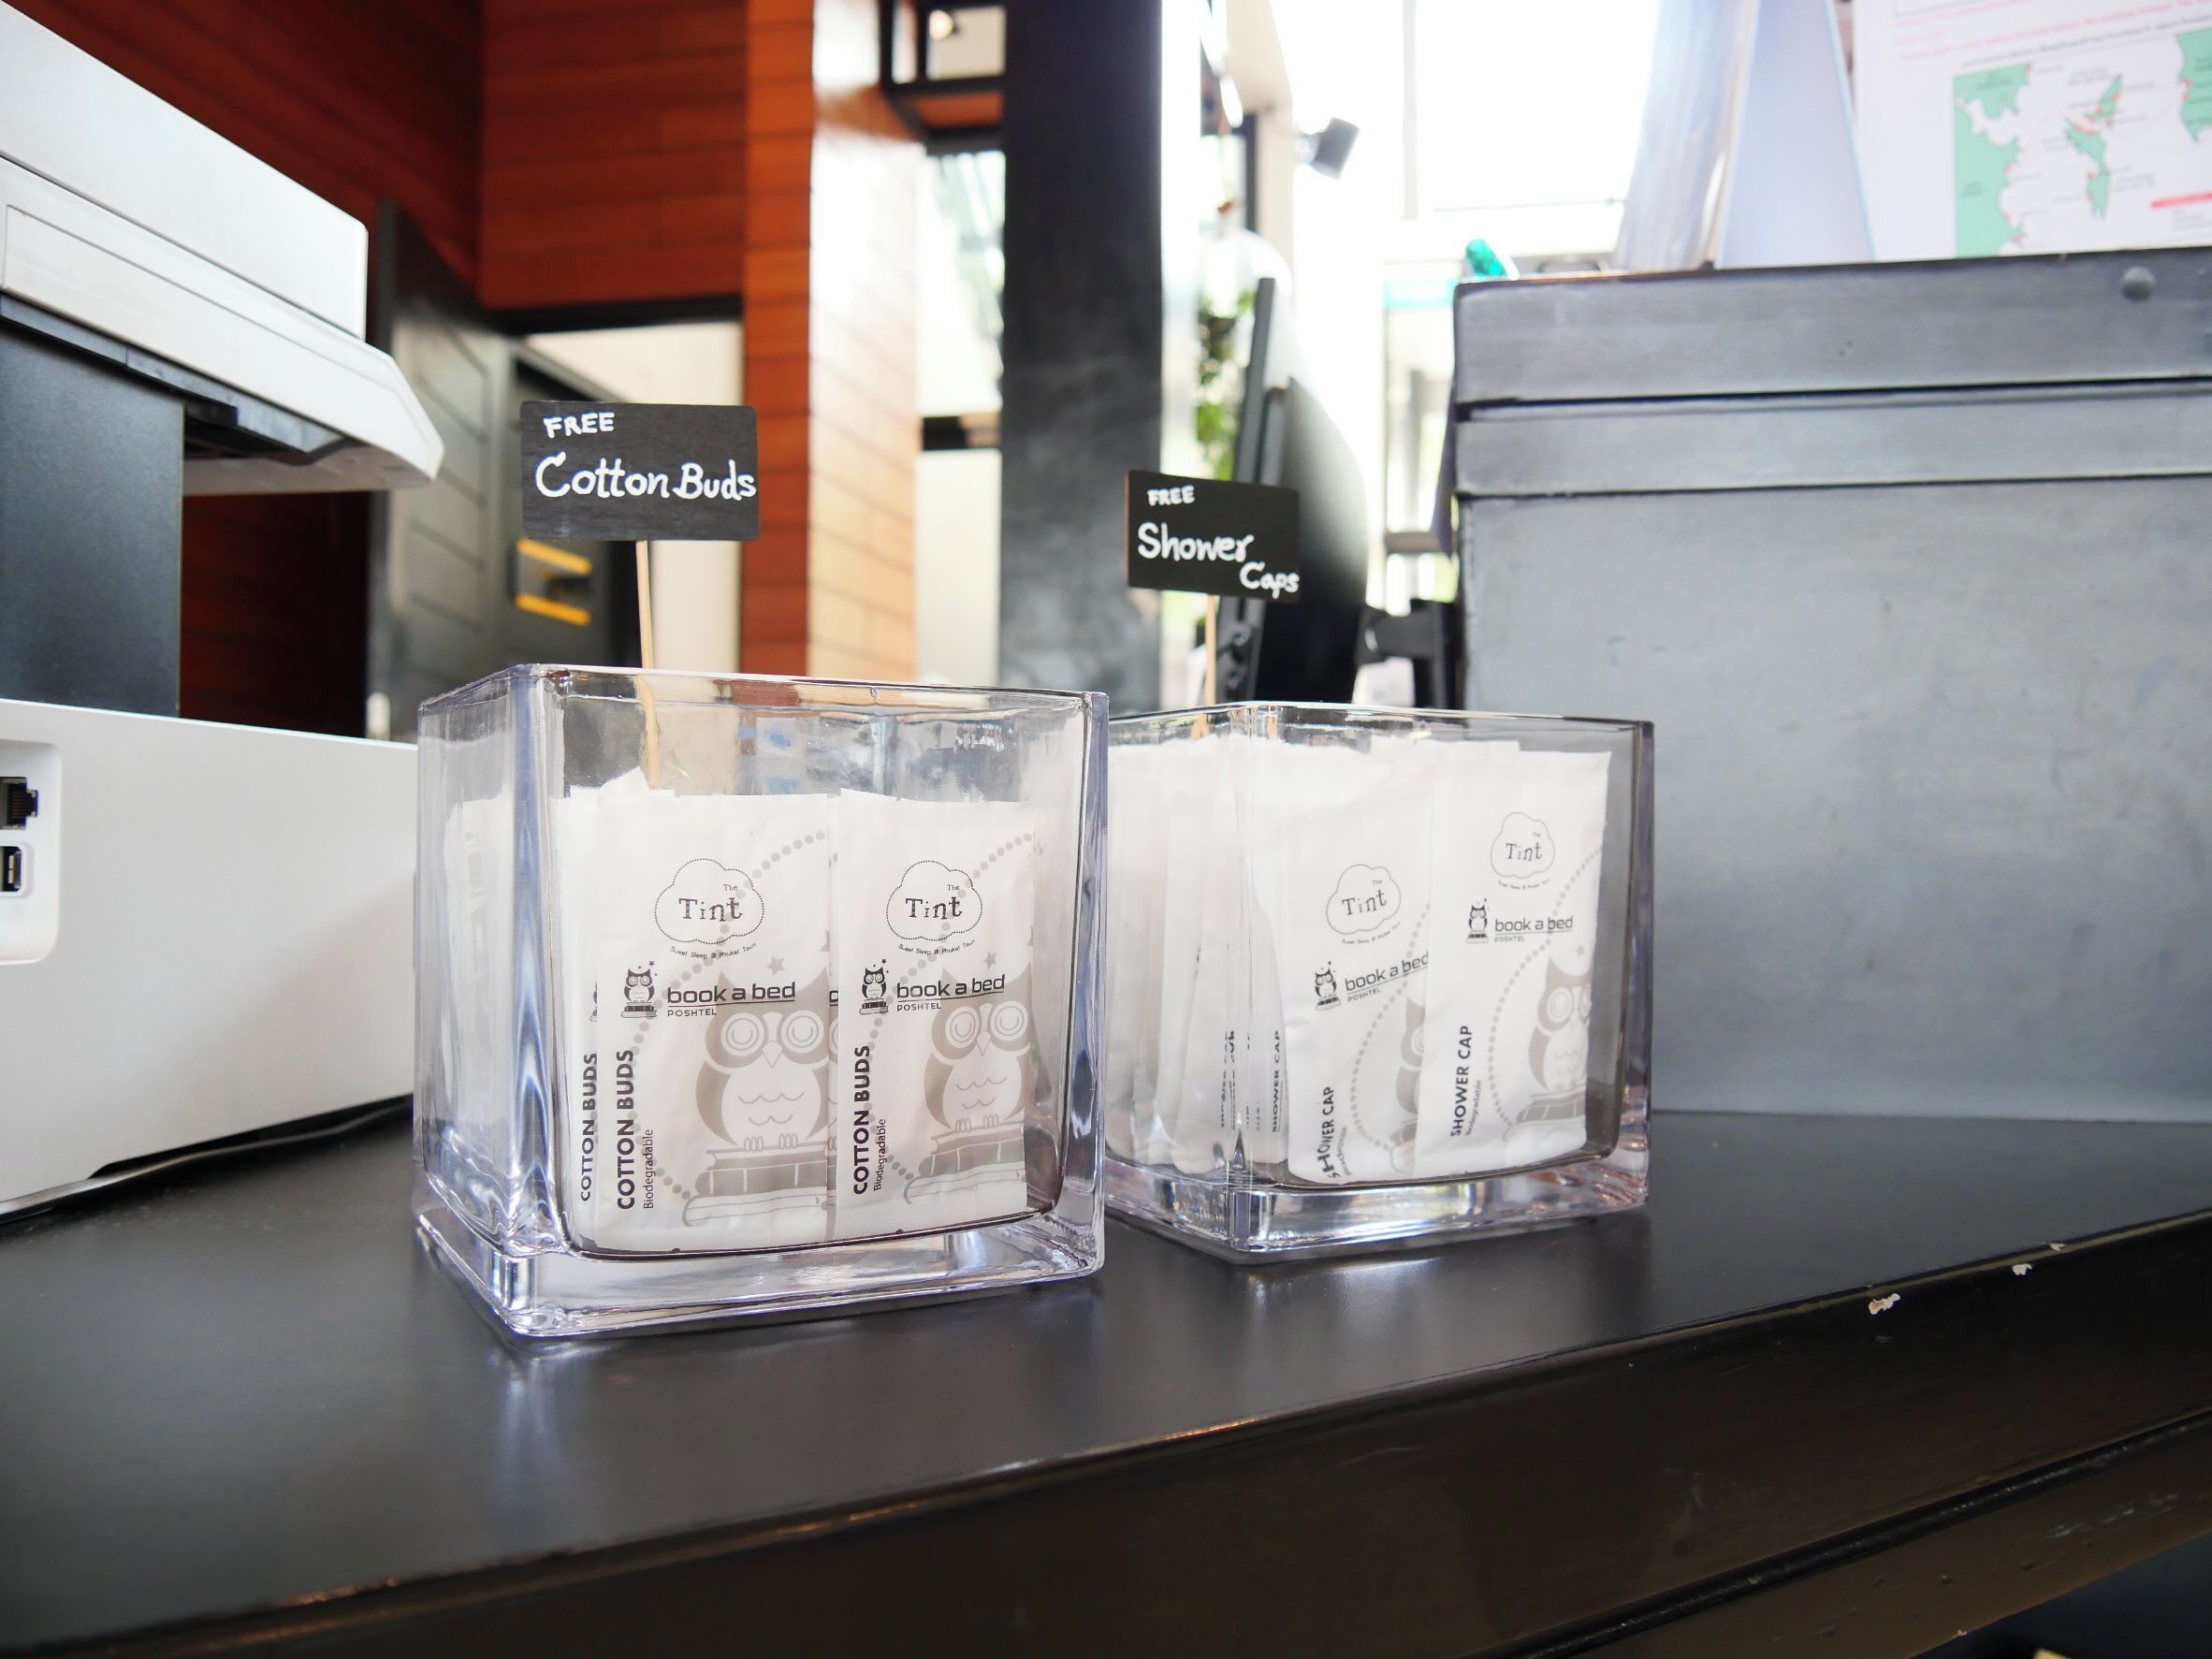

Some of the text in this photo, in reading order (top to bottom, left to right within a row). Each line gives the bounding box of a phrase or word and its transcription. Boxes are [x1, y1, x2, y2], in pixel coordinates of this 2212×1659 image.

[543, 412, 615, 439] FREE
[535, 451, 757, 502] Cotton Buds
[1146, 485, 1196, 506] FREE
[1137, 522, 1255, 562] Shower
[1239, 561, 1301, 600] Caps
[1506, 842, 1543, 862] Tint
[723, 883, 738, 892] The
[947, 883, 960, 892] The
[678, 897, 743, 922] Tint
[905, 896, 963, 920] Tint
[1342, 889, 1387, 916] Tint
[1494, 915, 1574, 932] book a bed
[1345, 950, 1429, 992] book a bed
[667, 982, 796, 1004] book a bed
[896, 974, 1006, 998] book a bed
[667, 1008, 718, 1017] POSHTEL
[896, 1002, 942, 1012] POSHTEL
[1450, 1026, 1473, 1137] SHOWER CAP
[581, 1053, 598, 1202] COTTON BUDS
[616, 1050, 635, 1210] COTTON BUDS
[853, 1045, 870, 1195] COTTON BUDS
[1317, 1086, 1341, 1179] SHOWER CAP
[873, 1118, 888, 1191] Biodegradable
[643, 1129, 656, 1209] Biodegradable
